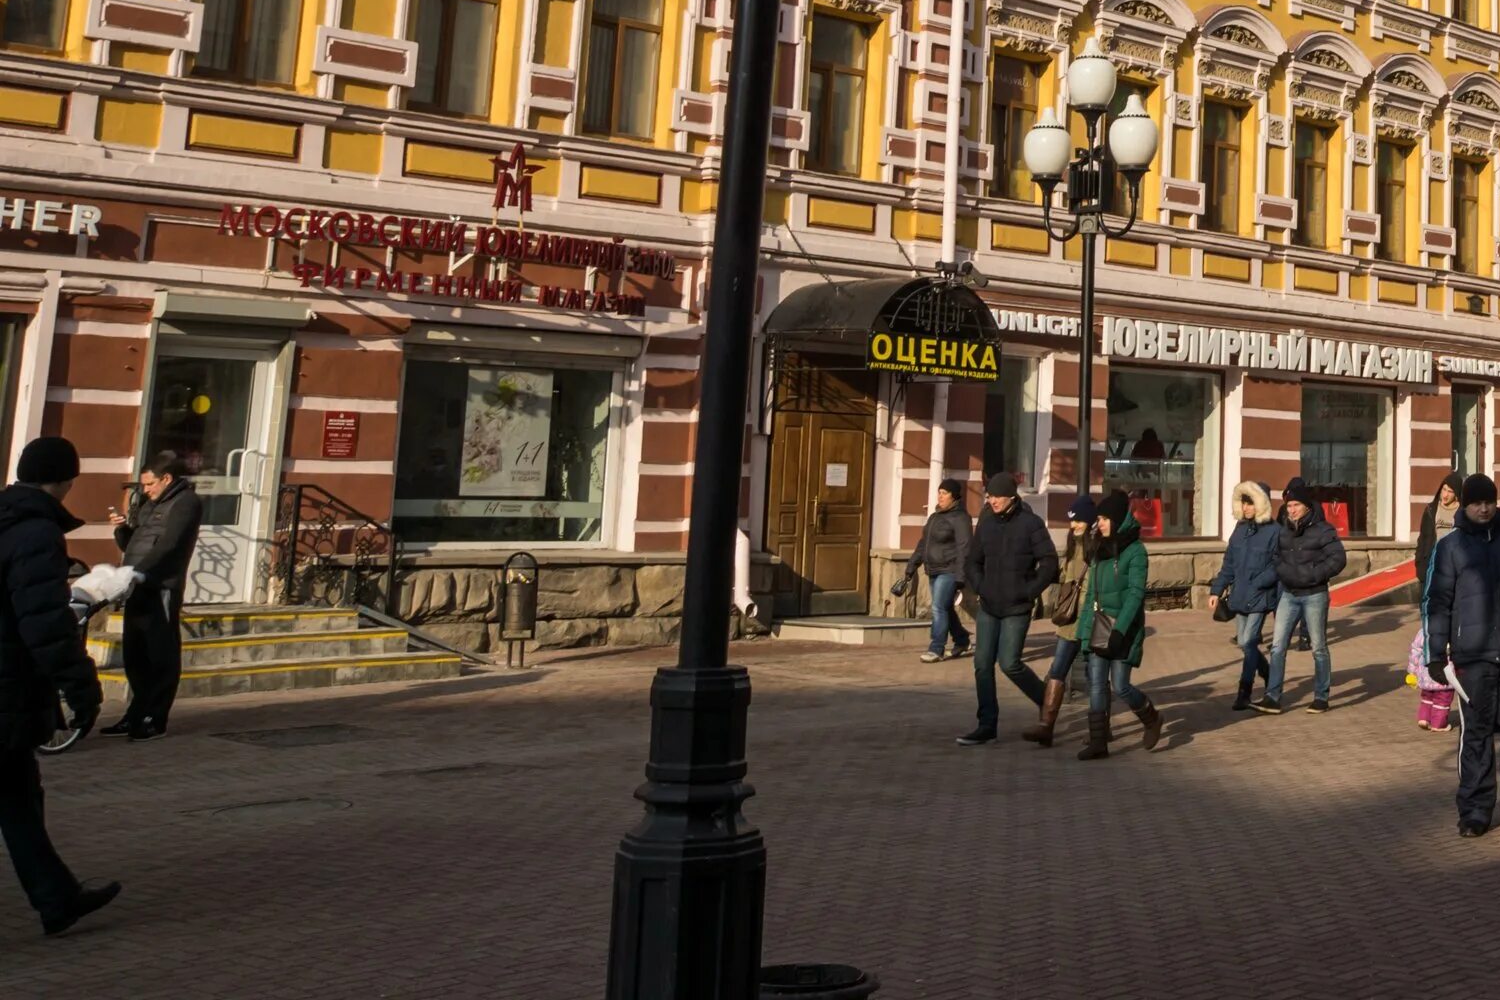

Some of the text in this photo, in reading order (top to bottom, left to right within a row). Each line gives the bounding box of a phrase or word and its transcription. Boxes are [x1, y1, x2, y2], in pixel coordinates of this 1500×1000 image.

[217, 203, 467, 251] МОСКОВСКИЙ
[474, 226, 626, 272] ЮВЕЛИРНЫЙ
[872, 333, 997, 370] ОЦЕНКА
[1102, 316, 1433, 384] ЮВЕЛИРНЫЙ МАГАЗИН
